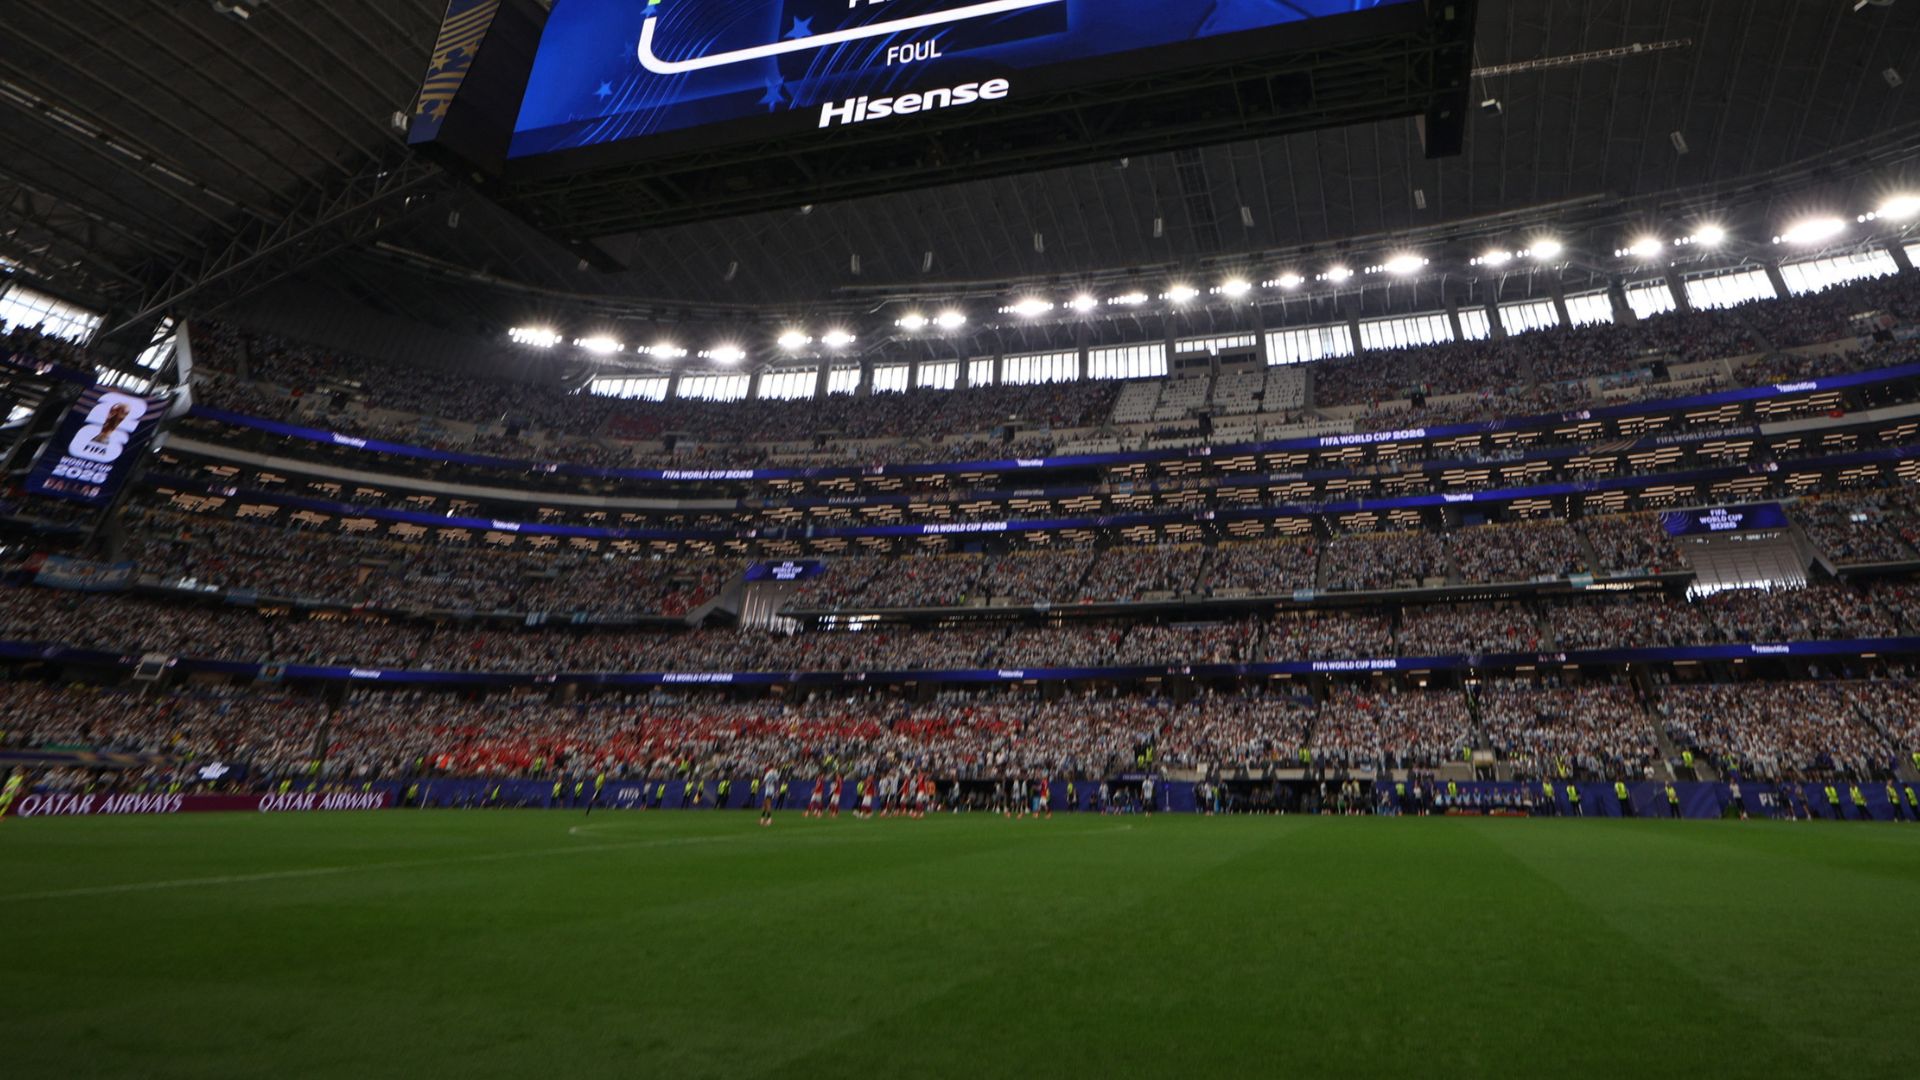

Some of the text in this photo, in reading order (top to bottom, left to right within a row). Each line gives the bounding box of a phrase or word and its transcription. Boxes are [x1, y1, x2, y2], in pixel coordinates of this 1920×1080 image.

[887, 40, 942, 66] FOUL
[818, 78, 1010, 128] Hisense
[1320, 428, 1426, 447] FIFA WORLD CUP 2026
[83, 444, 107, 455] FIFA
[52, 464, 109, 484] 2026
[923, 524, 939, 533] FIFA
[940, 523, 966, 533] WORLD
[966, 522, 982, 532] CUP
[1312, 661, 1329, 671] FIFA
[1329, 660, 1354, 670] WORLD
[1355, 659, 1370, 669] CUP
[17, 792, 185, 818] QATAR AIRWAYS
[258, 791, 385, 813] QATAR AIRWAYS
